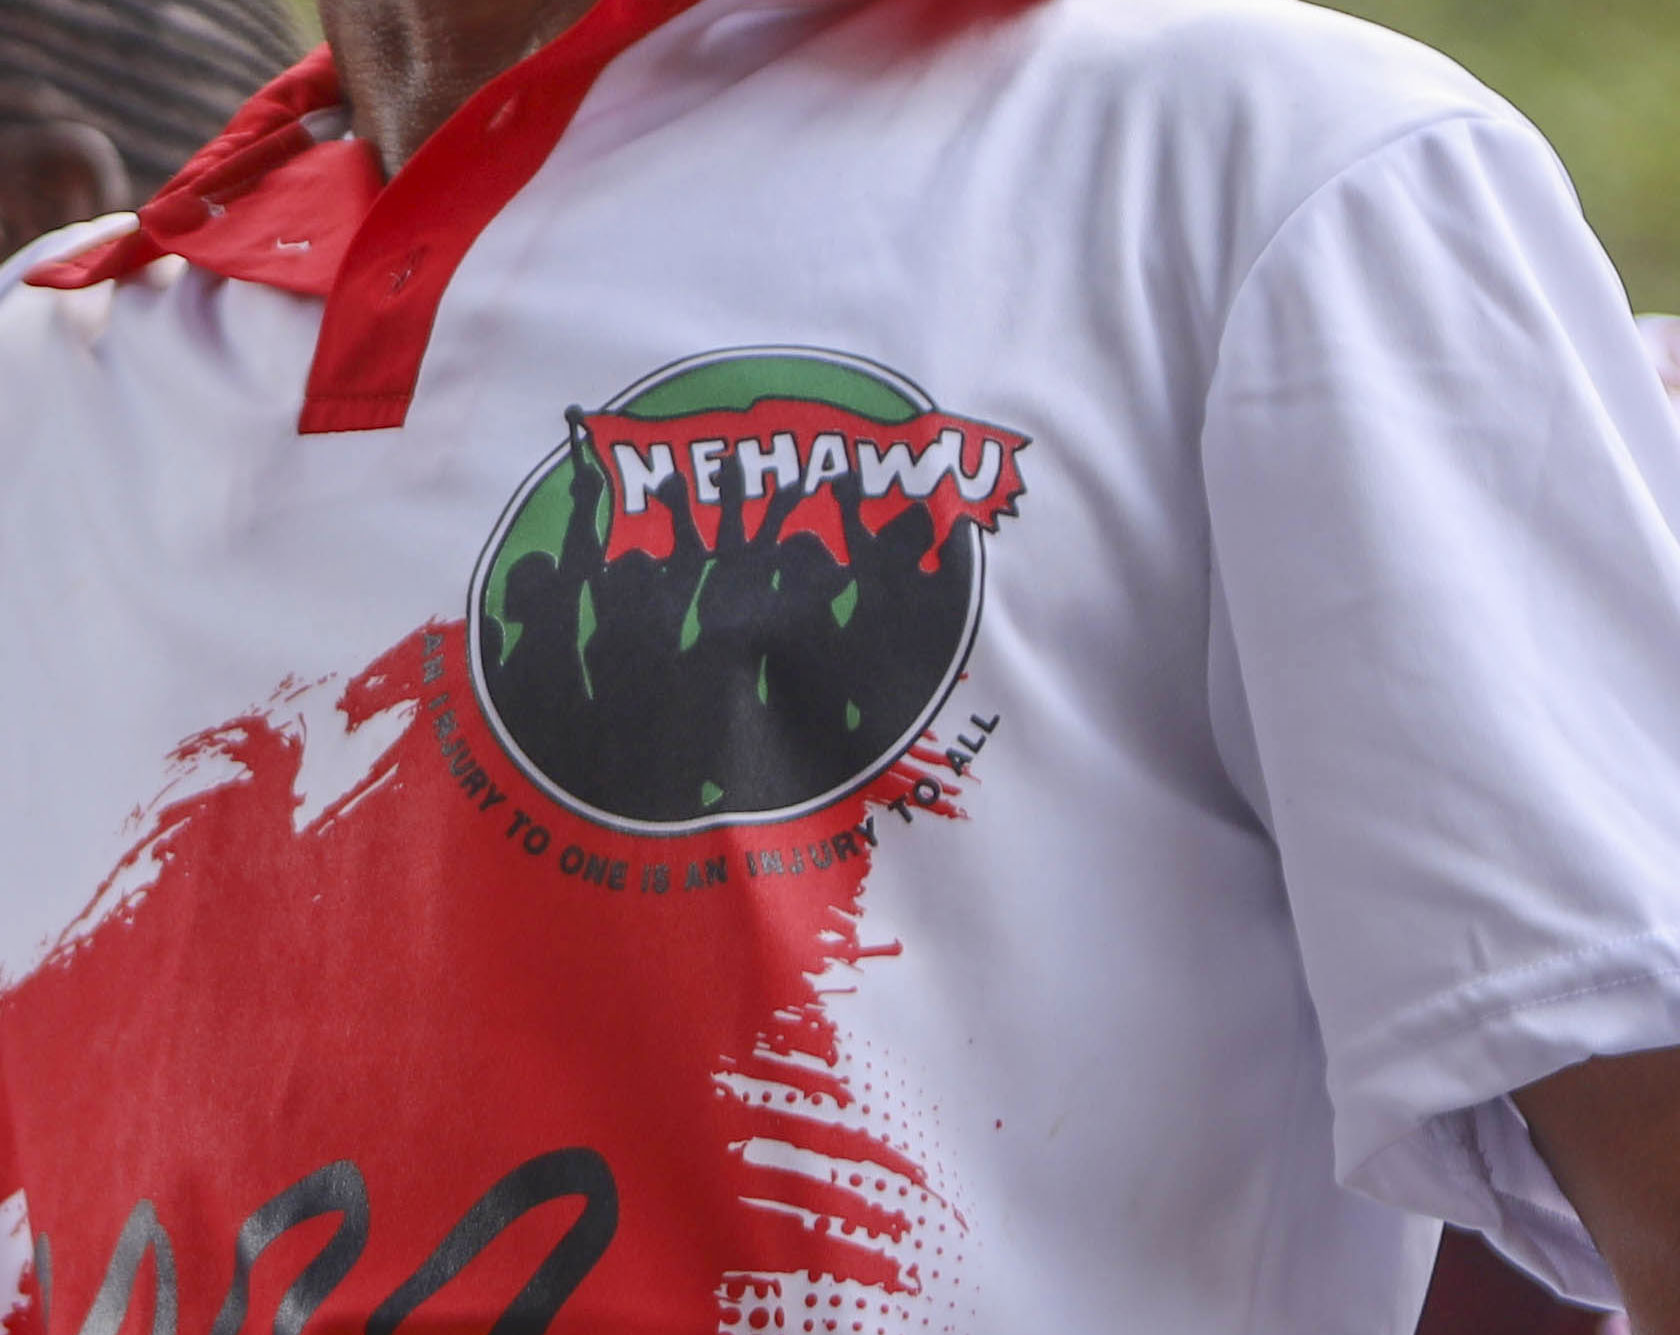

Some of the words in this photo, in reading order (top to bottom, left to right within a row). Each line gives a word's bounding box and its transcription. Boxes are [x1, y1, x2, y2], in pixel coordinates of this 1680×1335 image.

[612, 430, 1002, 515] NEHAWU
[506, 810, 550, 855] TO
[560, 846, 628, 890] ONE
[642, 862, 670, 894] IS
[685, 856, 728, 889] AN
[745, 816, 879, 877] INJURY
[887, 777, 942, 823] TO
[943, 713, 1000, 776] ALL
